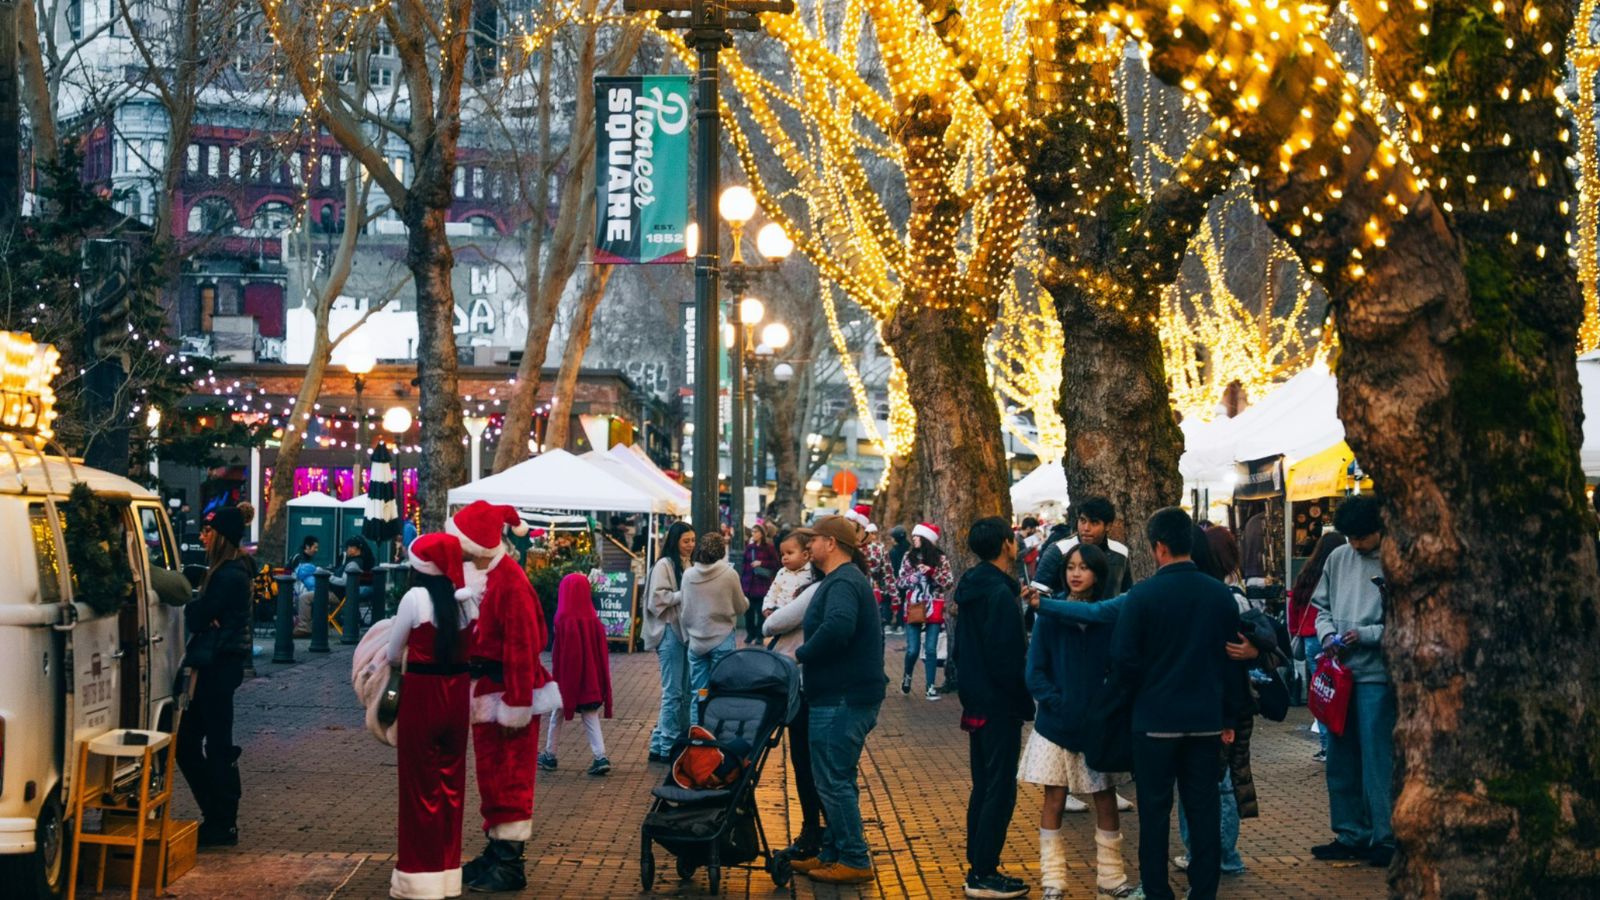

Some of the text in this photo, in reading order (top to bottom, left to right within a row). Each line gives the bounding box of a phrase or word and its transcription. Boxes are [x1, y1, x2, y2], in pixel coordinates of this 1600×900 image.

[605, 88, 632, 242] SQUARE
[634, 87, 688, 209] Pioneer
[646, 233, 685, 243] 1852
